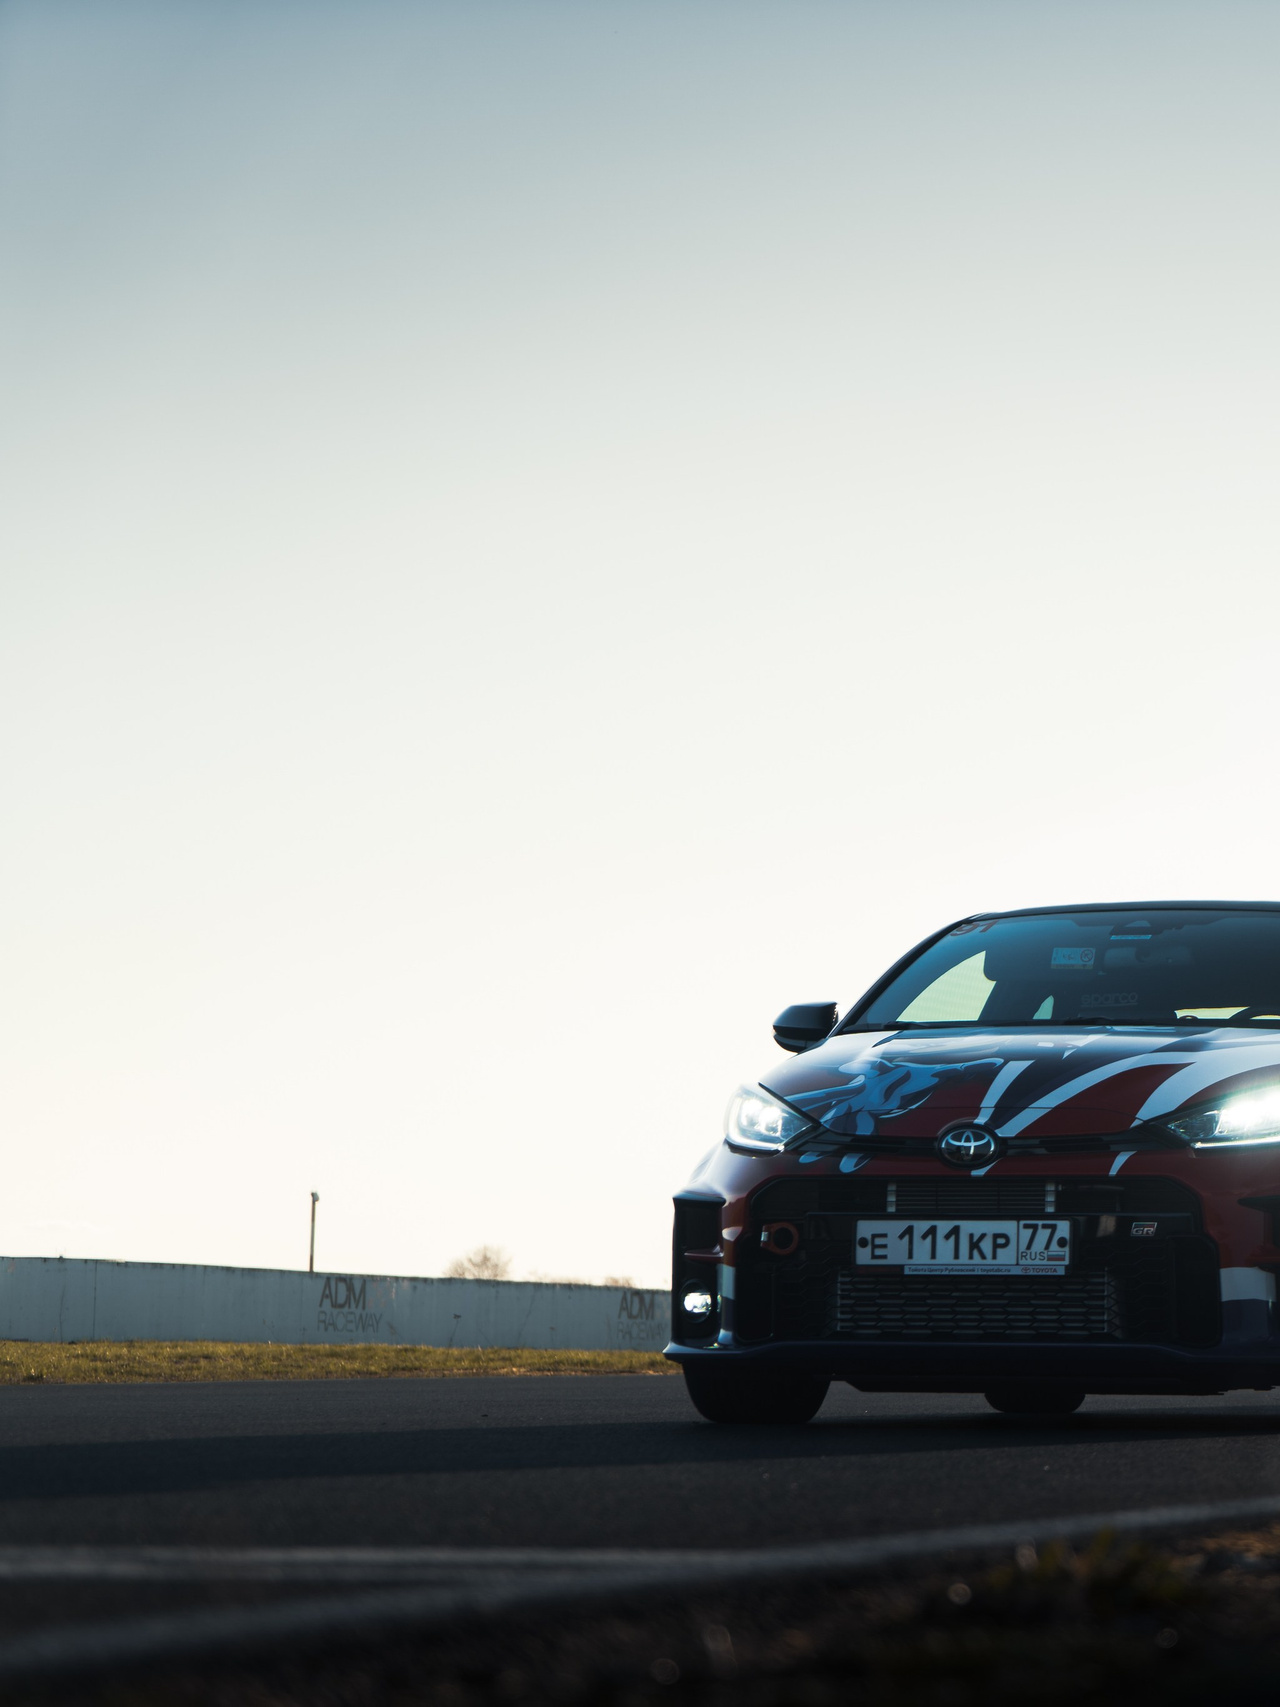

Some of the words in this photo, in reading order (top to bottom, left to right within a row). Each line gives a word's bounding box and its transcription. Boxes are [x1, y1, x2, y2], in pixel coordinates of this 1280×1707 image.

[1080, 992, 1138, 1007] sparco
[1022, 1223, 1058, 1251] 77
[1132, 1227, 1154, 1235] GR
[1020, 1251, 1046, 1261] RUS
[318, 1276, 367, 1311] ADM
[617, 1290, 656, 1321] ADM
[317, 1310, 383, 1333] RACEWAY
[616, 1320, 668, 1342] RACEWAY
